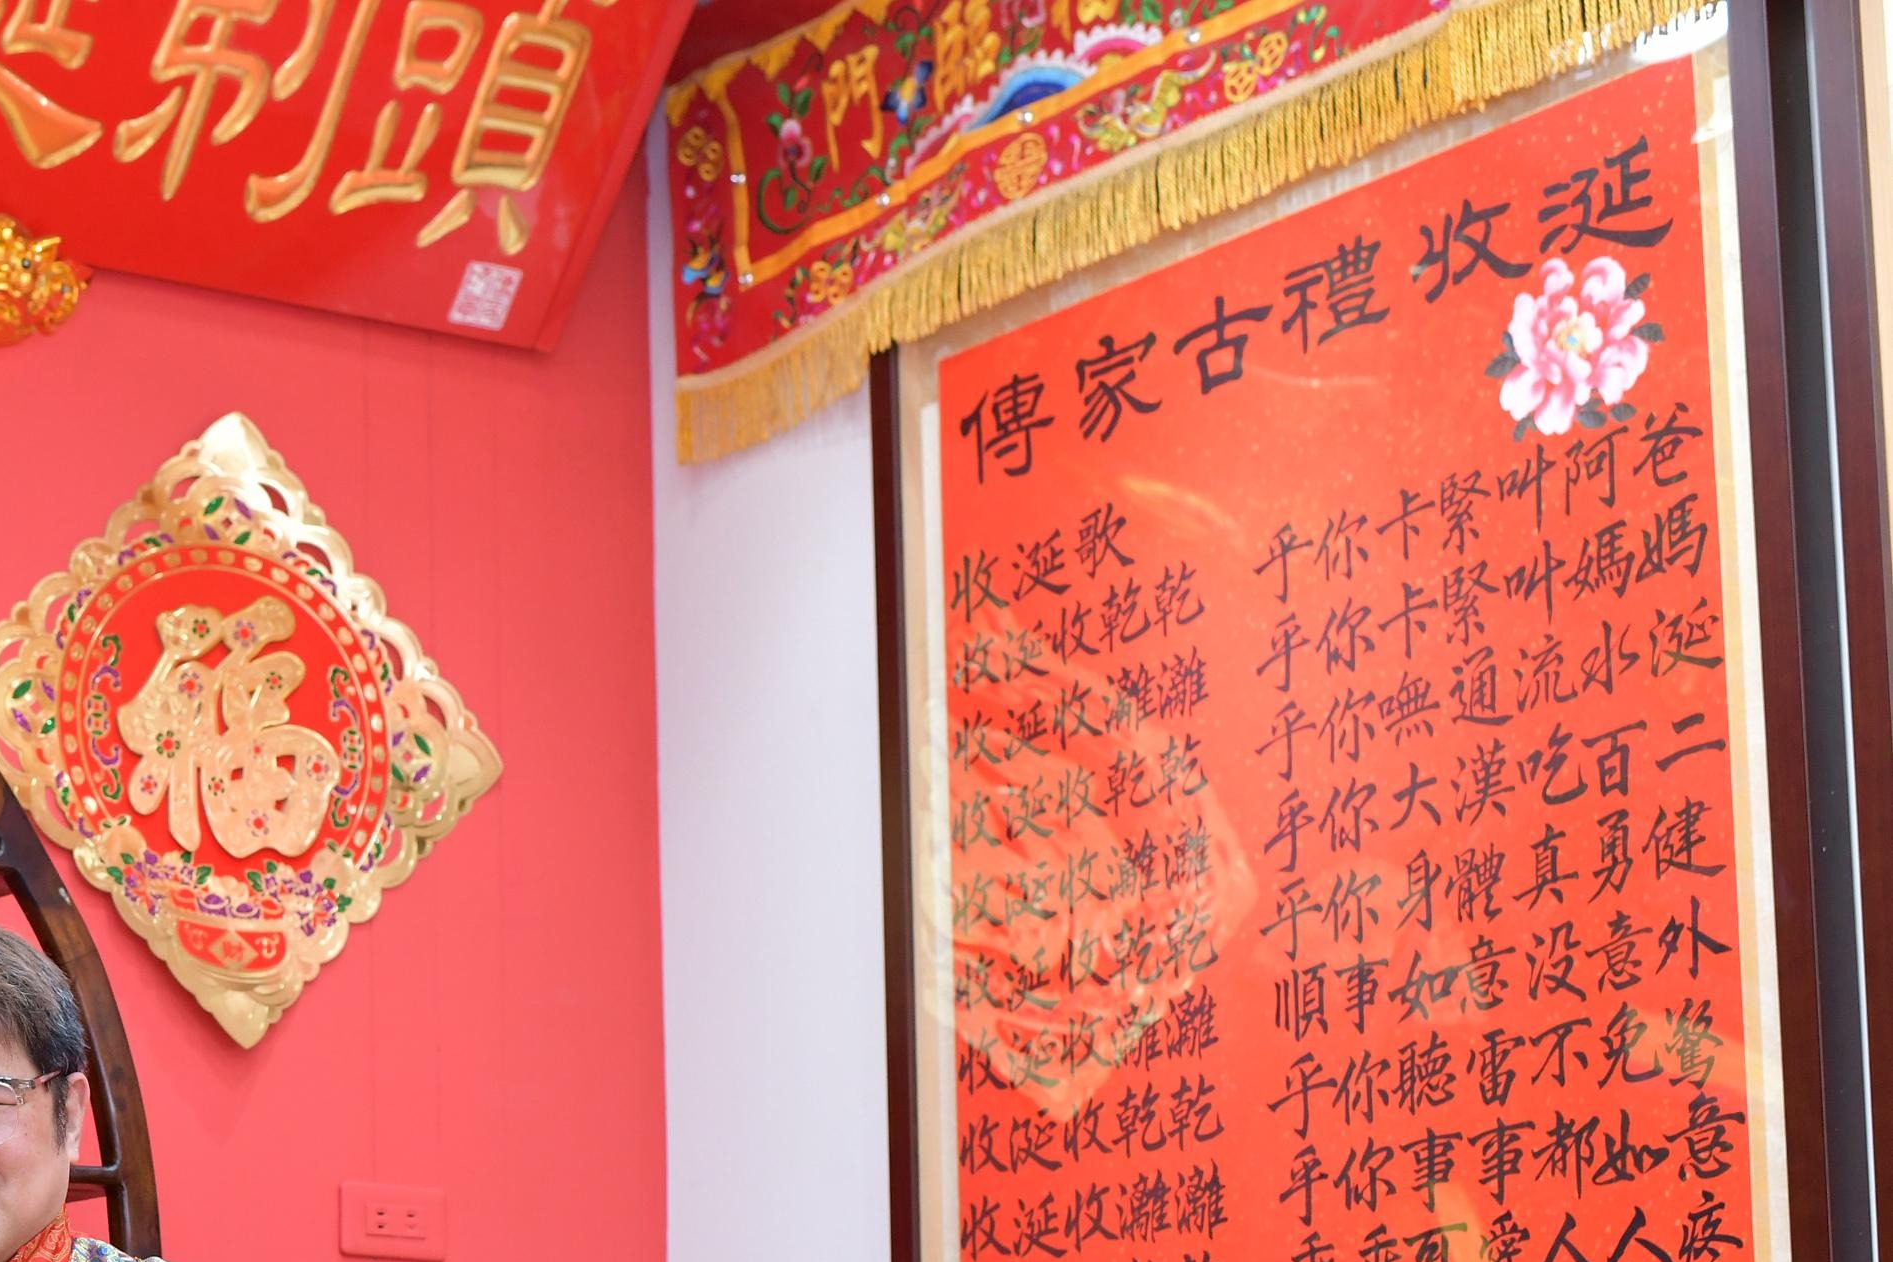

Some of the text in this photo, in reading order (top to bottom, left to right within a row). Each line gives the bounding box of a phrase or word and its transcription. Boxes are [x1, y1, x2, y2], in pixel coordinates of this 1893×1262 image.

[959, 135, 1674, 485] 傳家古禮收涎
[951, 503, 1135, 623] 收涎歌
[117, 595, 342, 860] 福
